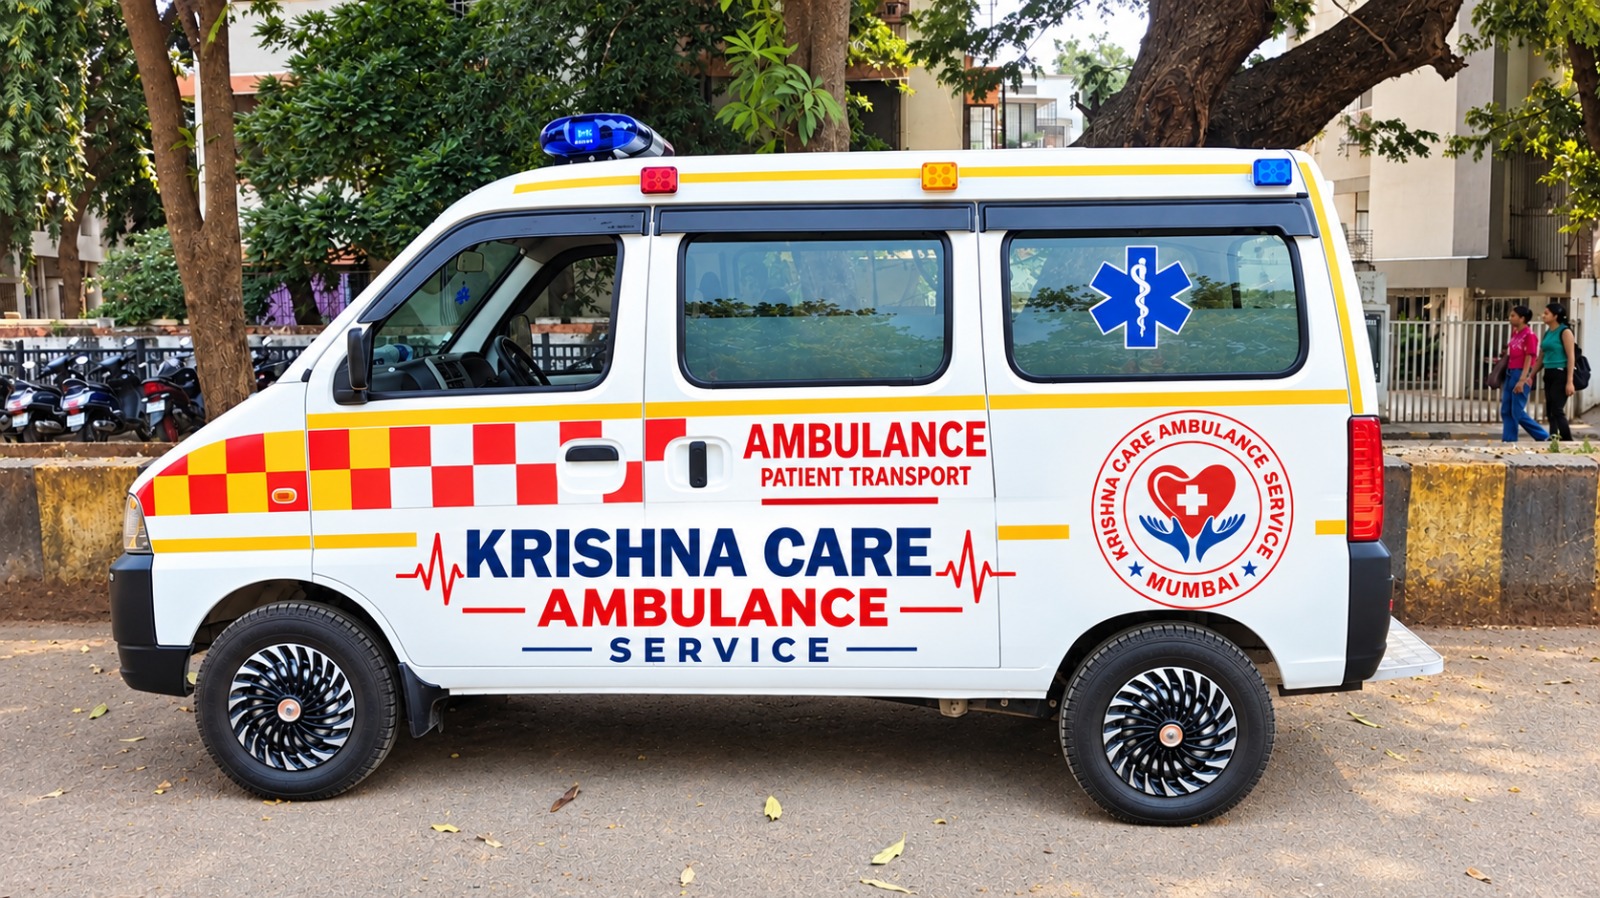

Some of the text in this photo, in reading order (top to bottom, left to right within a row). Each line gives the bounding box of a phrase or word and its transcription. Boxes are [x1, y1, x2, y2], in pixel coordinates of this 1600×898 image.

[743, 421, 987, 459] AMBULANCE
[760, 466, 971, 487] PATIENT TRANSPORT
[1100, 419, 1285, 561] KRISHNA CARE AMBULANCE SERVICE
[466, 527, 932, 578] KRISHNA CARE
[1146, 572, 1240, 598] MUMBAI
[537, 588, 889, 627] AMBULANCE
[609, 637, 830, 663] SERVICE
